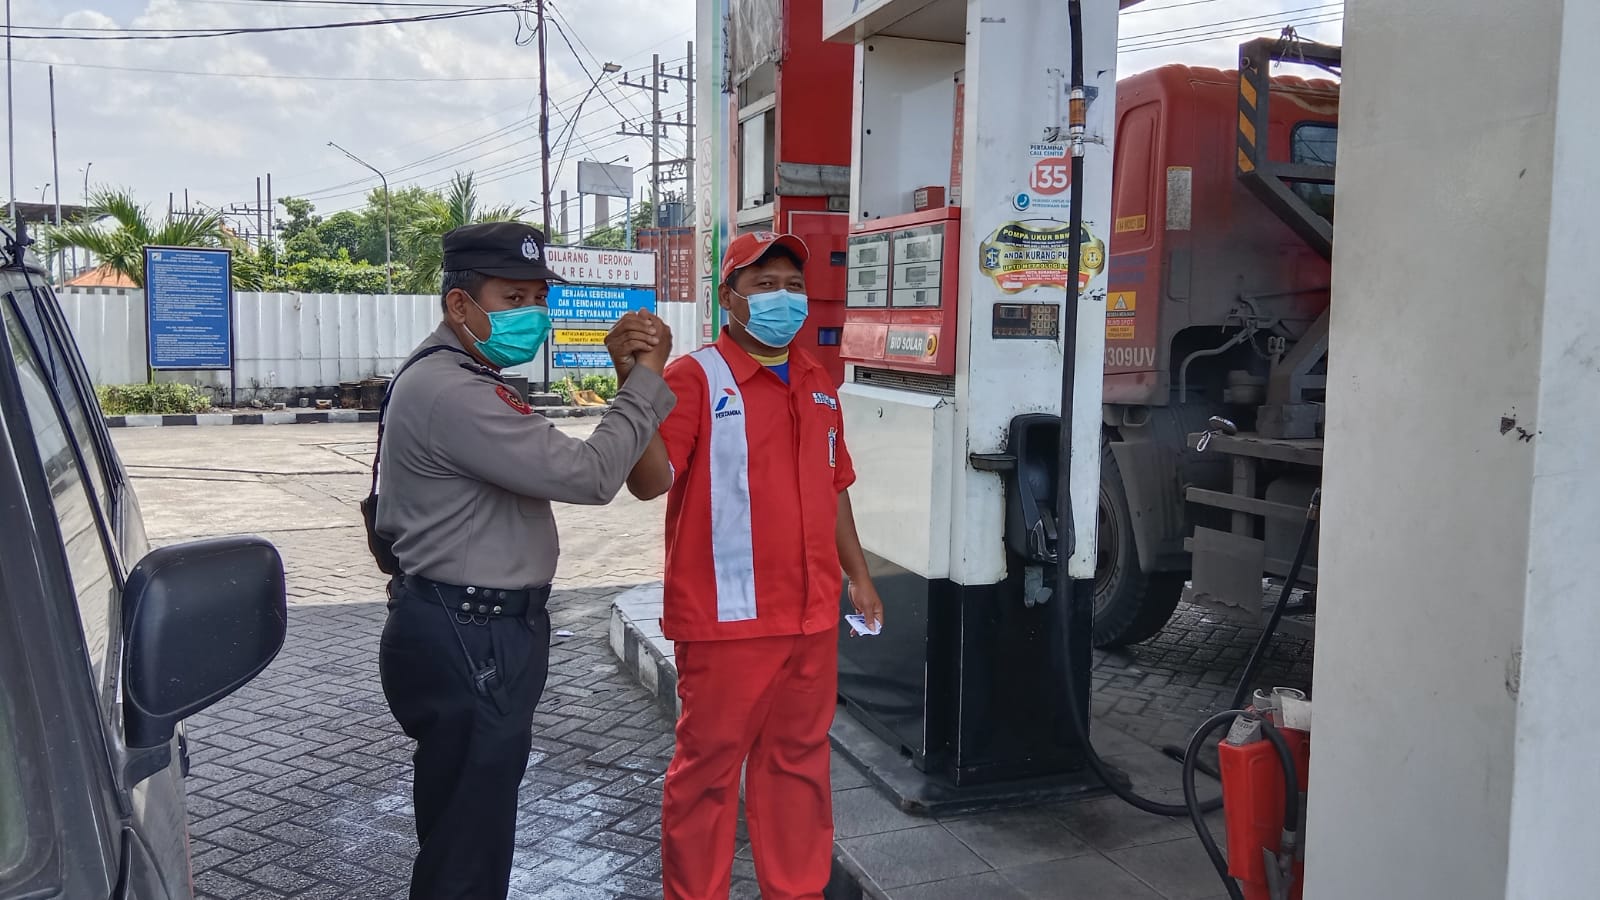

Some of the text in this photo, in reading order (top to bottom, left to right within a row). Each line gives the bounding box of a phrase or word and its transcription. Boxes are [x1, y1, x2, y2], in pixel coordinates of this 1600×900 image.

[1031, 165, 1068, 189] 135
[1002, 229, 1029, 240] POMPA
[1031, 232, 1053, 240] UKUR
[548, 250, 633, 266] DILARANG MEROKOK
[1003, 251, 1024, 260] ANDA
[1025, 250, 1056, 261] KURANG
[561, 267, 602, 279] AREAL
[608, 269, 639, 280] SPBU
[562, 289, 588, 298] MENJAGA
[558, 298, 628, 309] DAN KEINDAHAN LOKASI
[889, 336, 923, 351] BIO SOLAR
